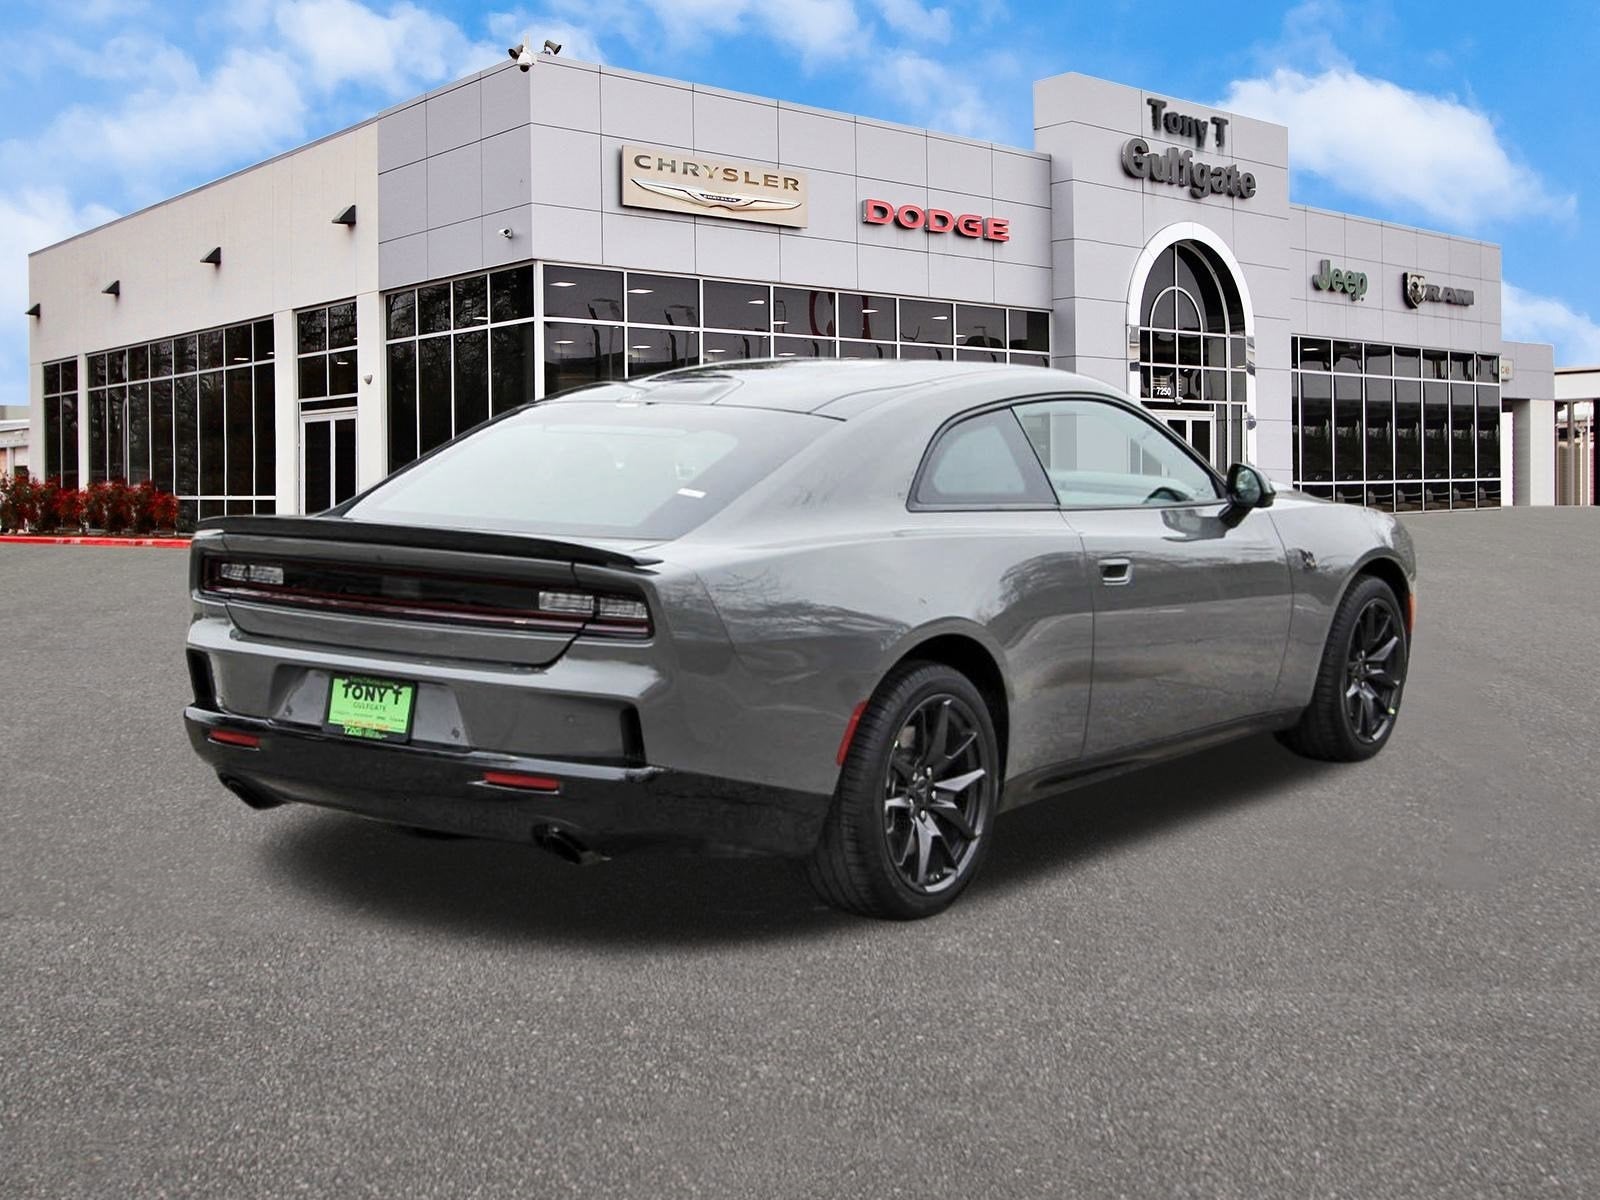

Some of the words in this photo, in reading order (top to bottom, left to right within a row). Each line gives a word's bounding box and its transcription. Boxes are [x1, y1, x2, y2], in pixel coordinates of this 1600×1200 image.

[1147, 98, 1208, 147] Tony
[1211, 117, 1229, 147] T
[634, 154, 800, 192] CHRYSLER
[1121, 138, 1256, 199] Gulfgate
[862, 198, 1010, 242] DODGE
[1312, 259, 1367, 301] Jeep
[1425, 284, 1474, 305] RAM
[1156, 386, 1171, 396] 7250
[341, 683, 388, 702] TONY
[393, 687, 402, 705] T
